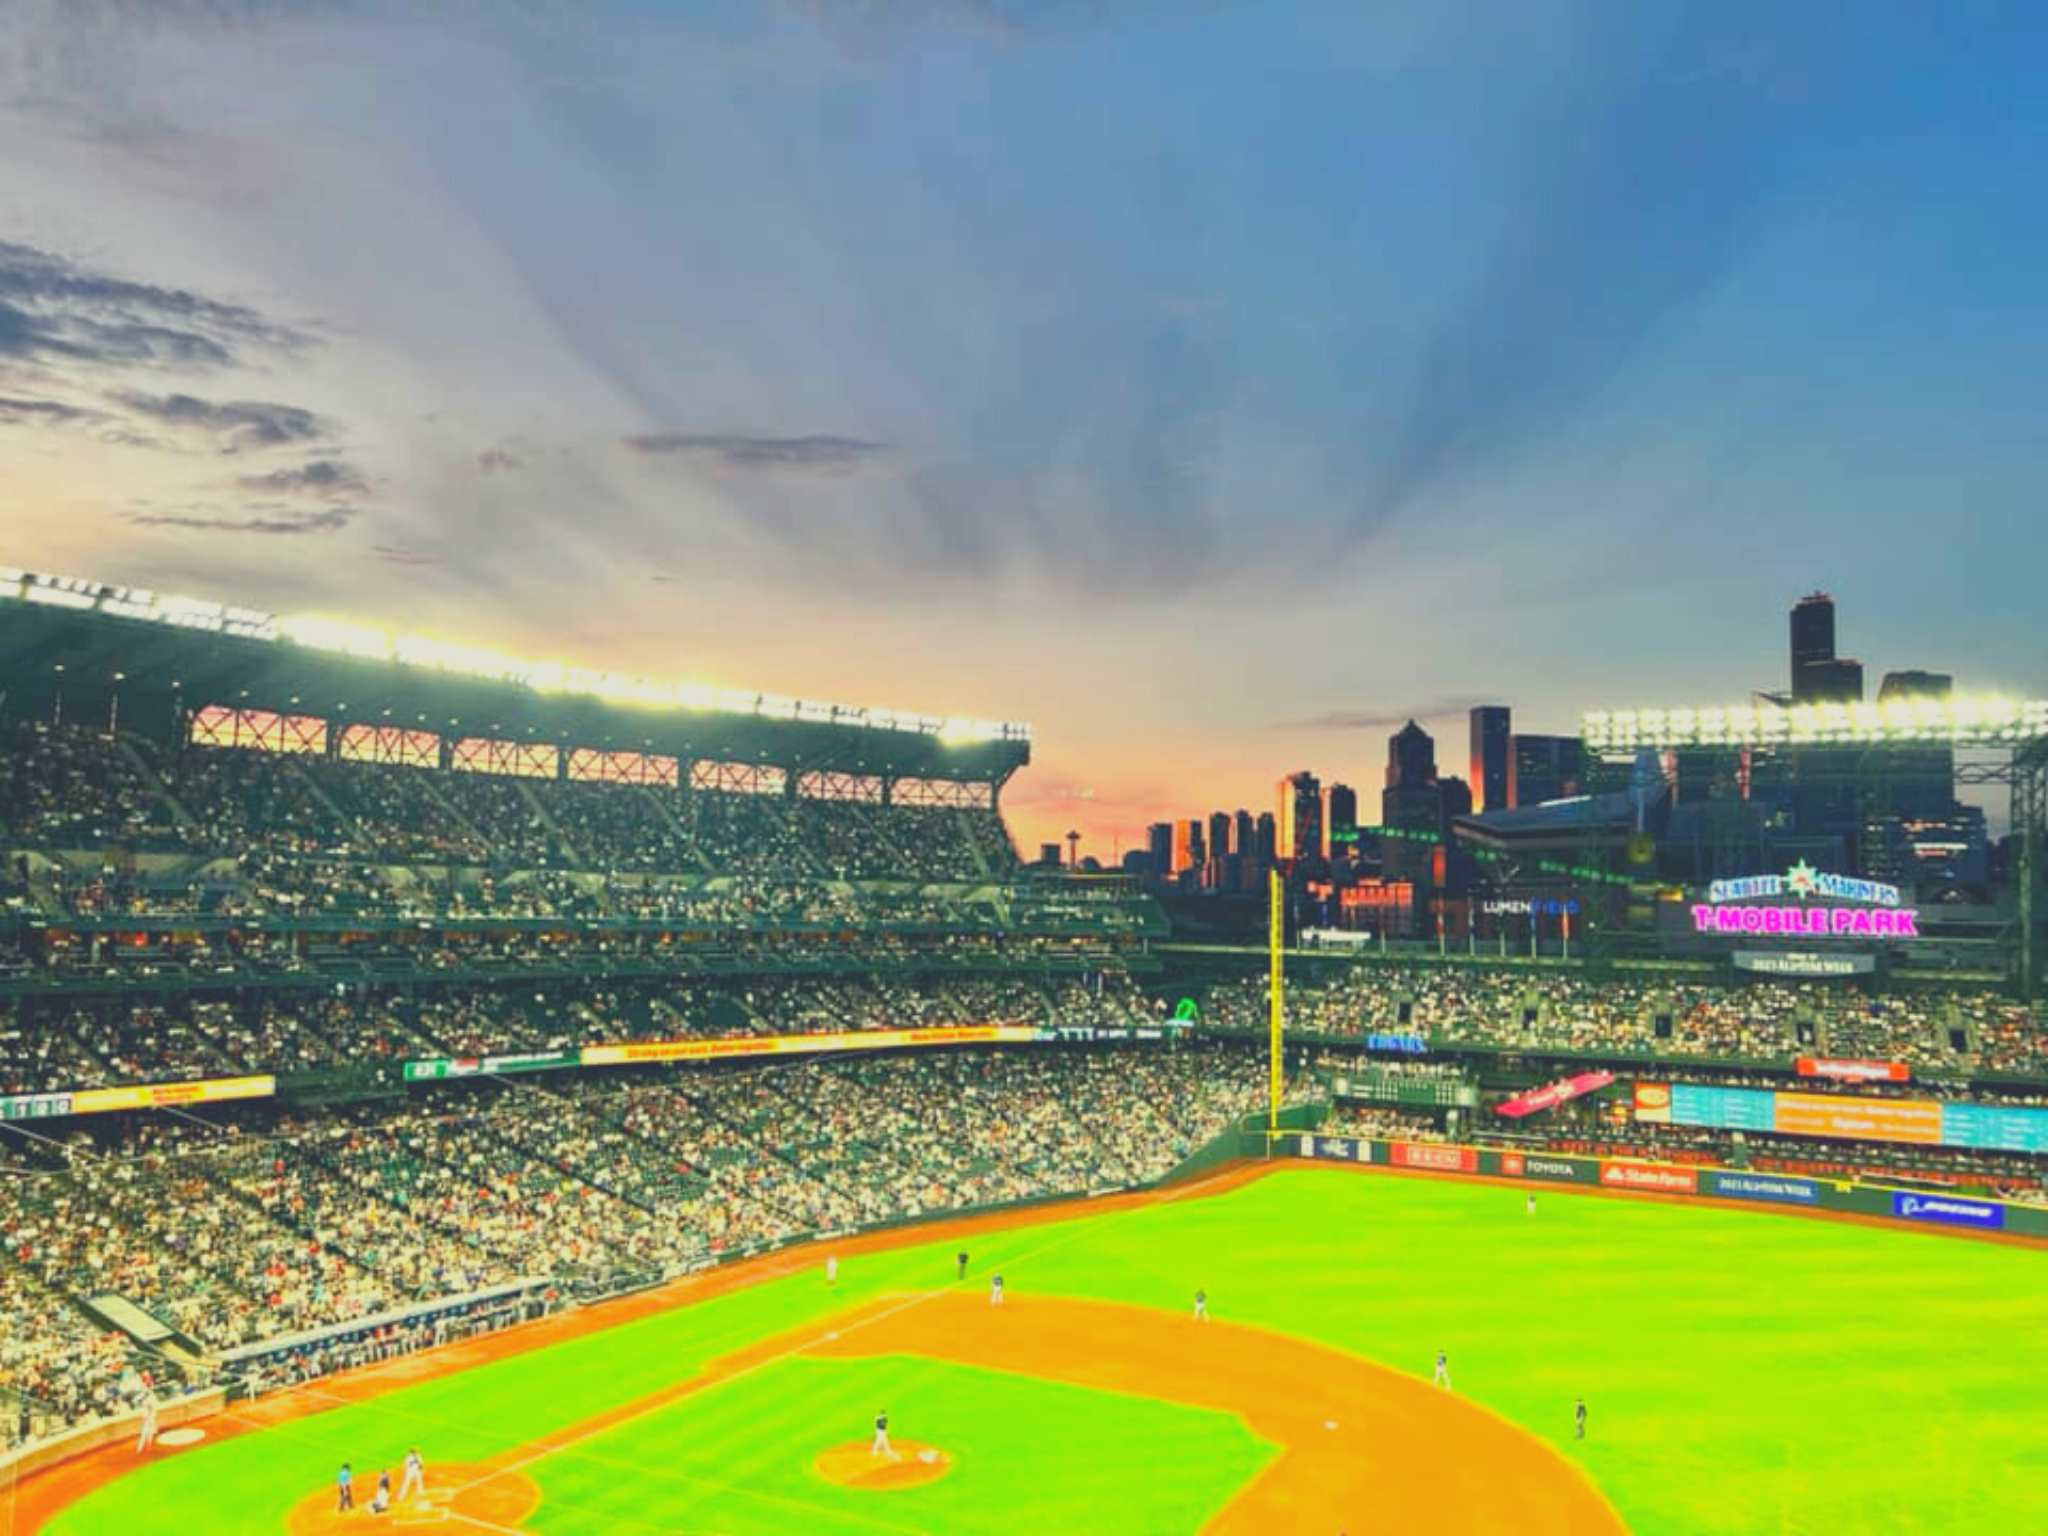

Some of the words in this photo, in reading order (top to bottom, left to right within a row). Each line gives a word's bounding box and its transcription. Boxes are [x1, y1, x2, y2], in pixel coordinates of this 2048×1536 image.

[1484, 901, 1531, 914] LUMEN
[1692, 905, 1828, 933] T-MOBILE
[1832, 907, 1918, 936] PARK
[1527, 1160, 1574, 1176] TOYOTA
[1625, 1168, 1658, 1183] State
[1658, 1171, 1691, 1187] Farm
